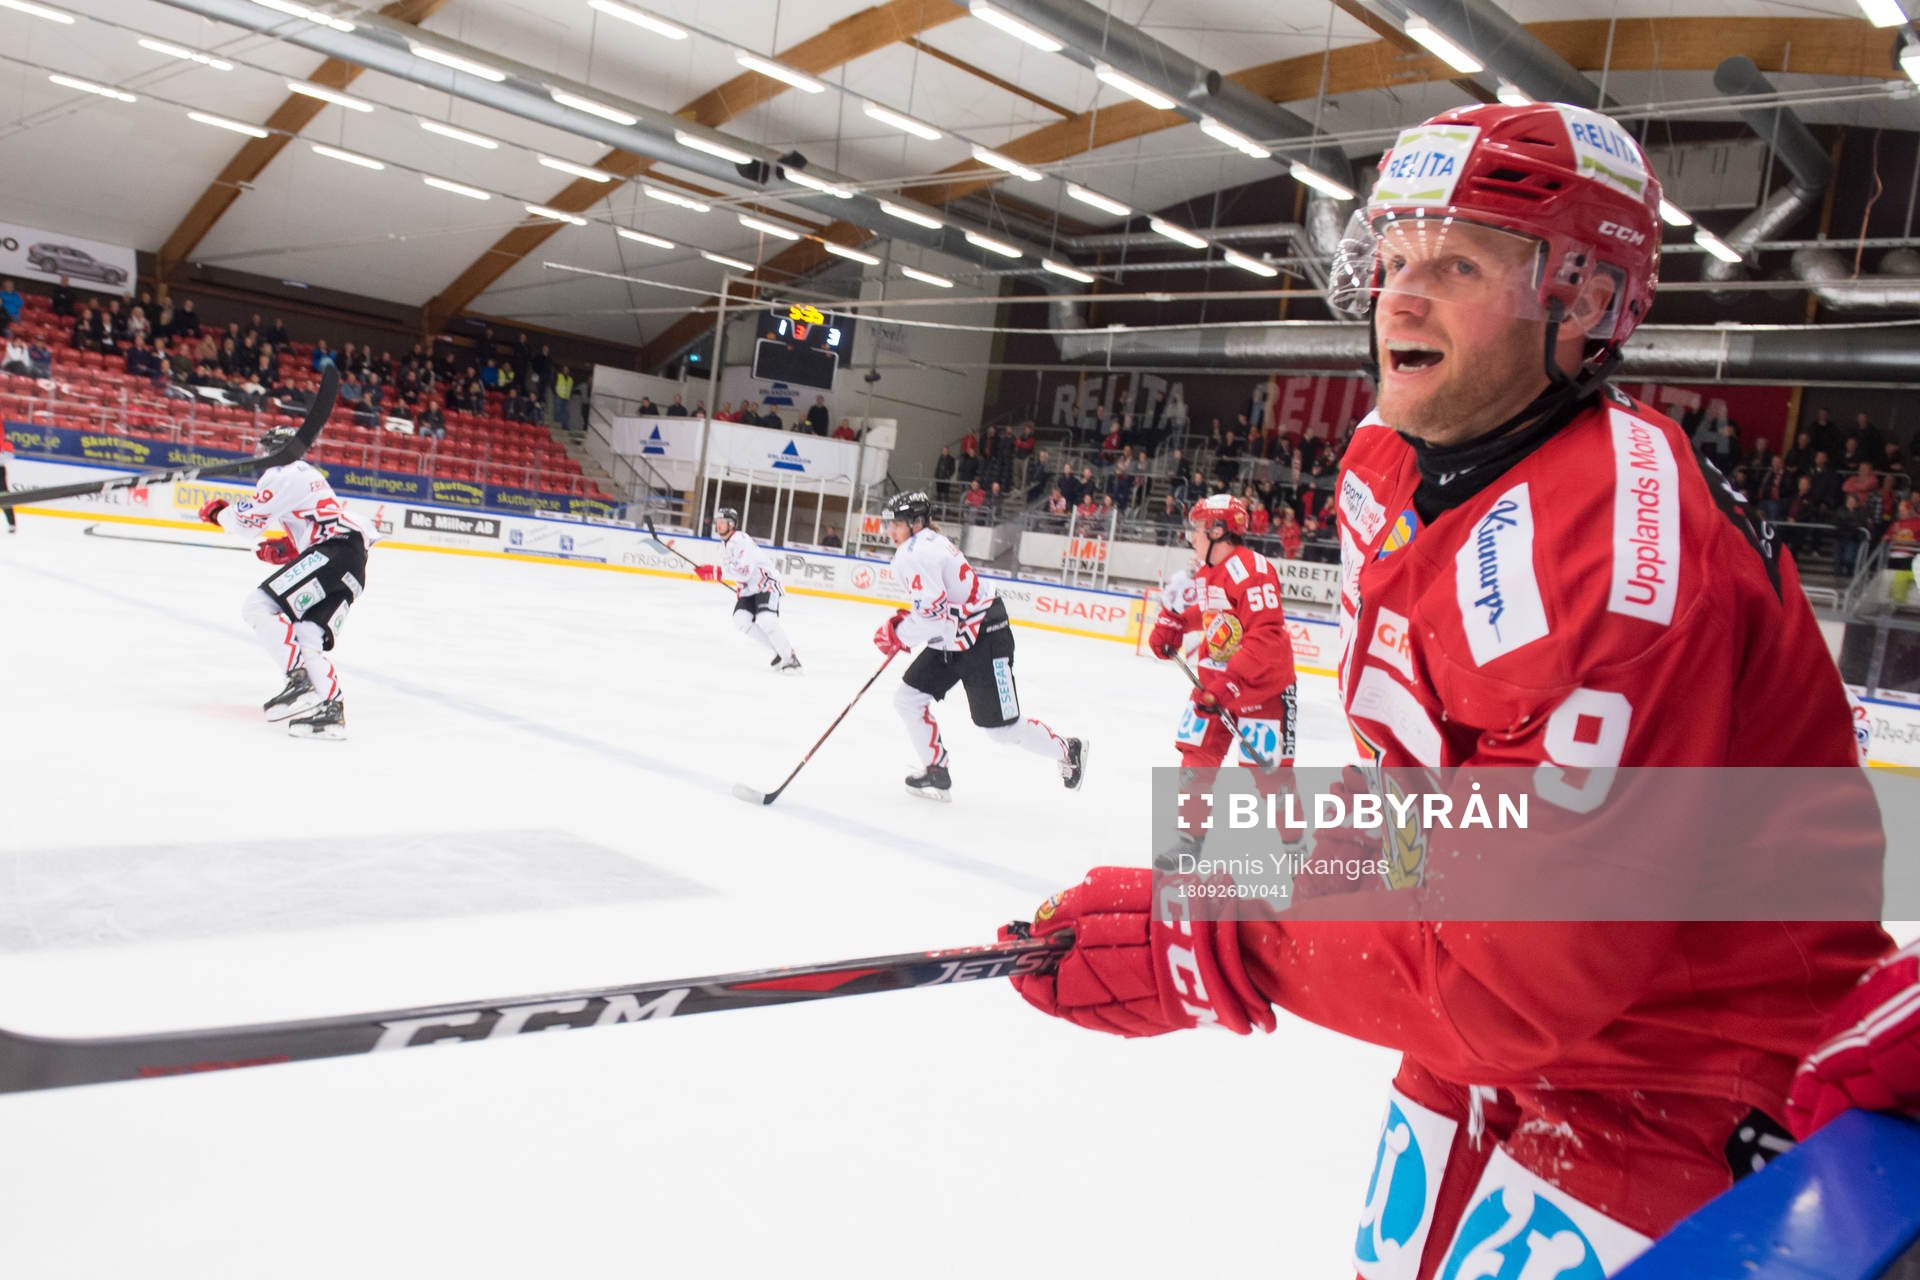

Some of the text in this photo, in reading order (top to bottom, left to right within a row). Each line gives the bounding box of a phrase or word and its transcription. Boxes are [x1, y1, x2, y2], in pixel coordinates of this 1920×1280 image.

[1571, 121, 1641, 166] RELITA
[1390, 151, 1455, 178] RELITA
[1598, 220, 1646, 246] CCM
[826, 327, 841, 346] 3
[1052, 374, 1190, 430] RELITA
[1250, 376, 1377, 438] RELIT
[177, 486, 209, 505] CITY
[1624, 421, 1668, 606] Upplands Motor
[411, 512, 494, 534] Mc Miller AB
[622, 551, 688, 569] FYRISHOV
[1475, 500, 1519, 627] Kinnarps
[1035, 595, 1127, 623] SHARP
[1246, 583, 1279, 612] 56
[1376, 622, 1411, 661] GR
[995, 661, 1012, 703] SEFAB
[1281, 684, 1298, 756] birgerja
[1532, 687, 1634, 815] 9
[370, 988, 691, 1051] CCM
